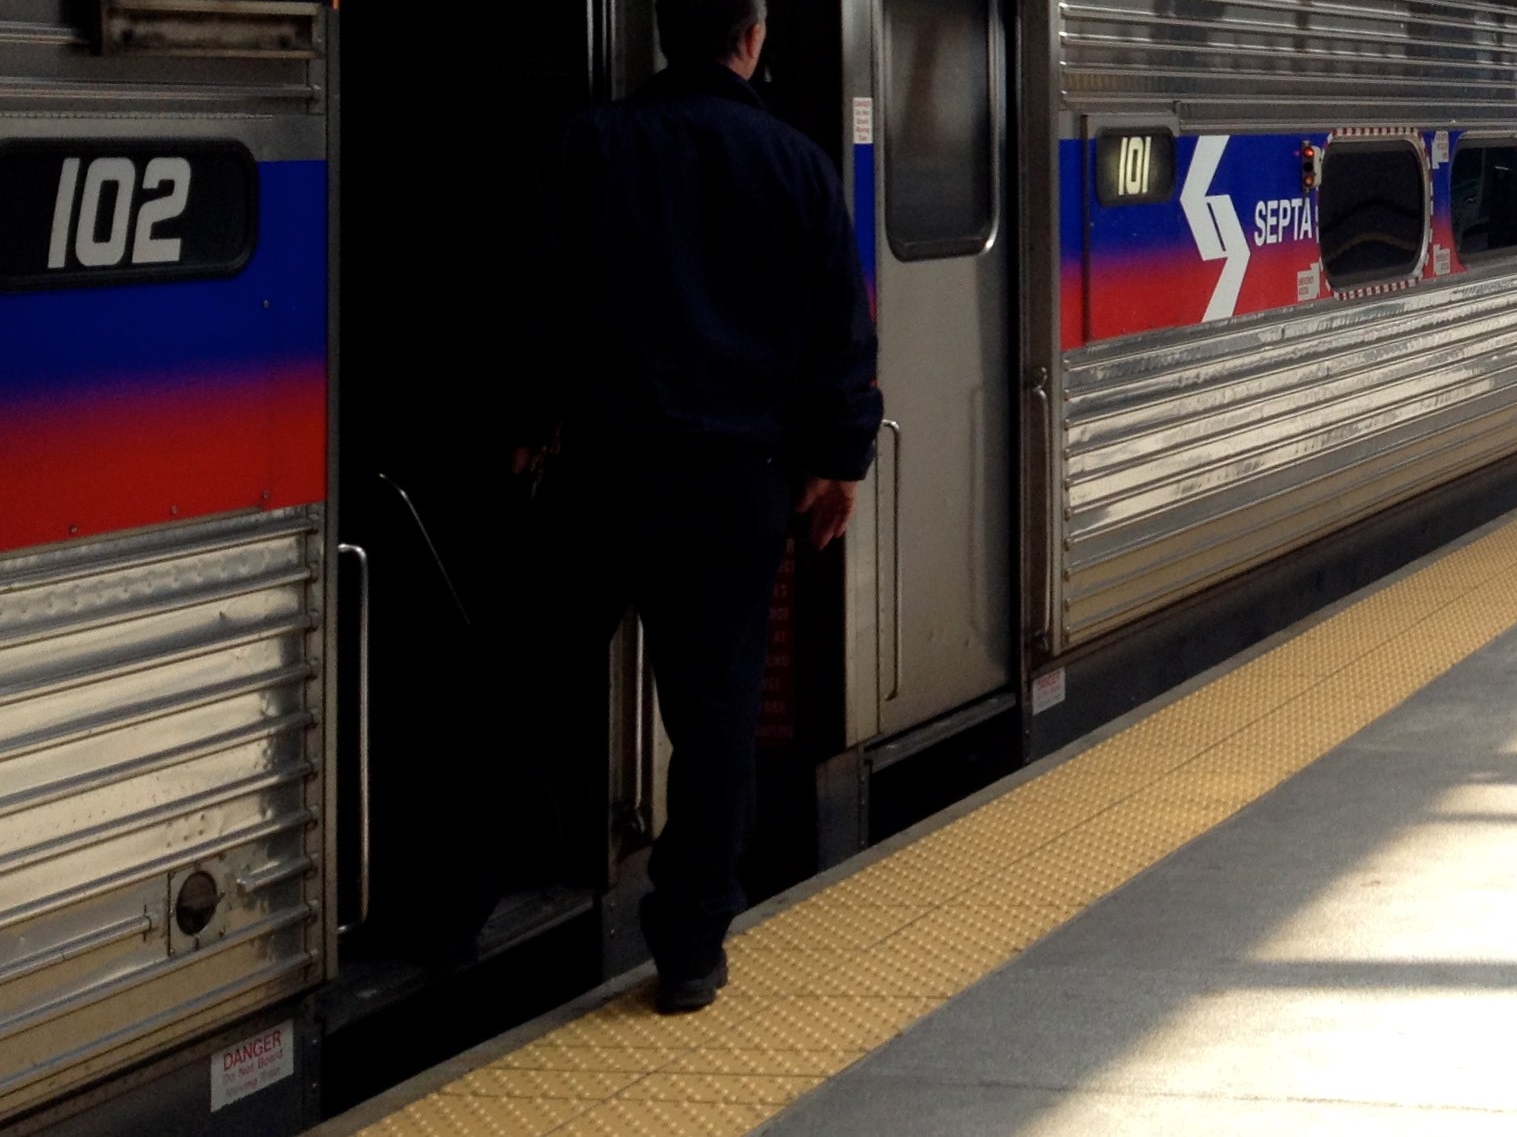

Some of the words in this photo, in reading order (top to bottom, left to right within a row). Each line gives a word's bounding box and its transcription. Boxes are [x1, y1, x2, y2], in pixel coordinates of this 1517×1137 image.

[1117, 136, 1151, 196] 101
[46, 156, 192, 270] 102
[1253, 197, 1313, 247] SEPTA
[223, 1029, 282, 1071] DANGER
